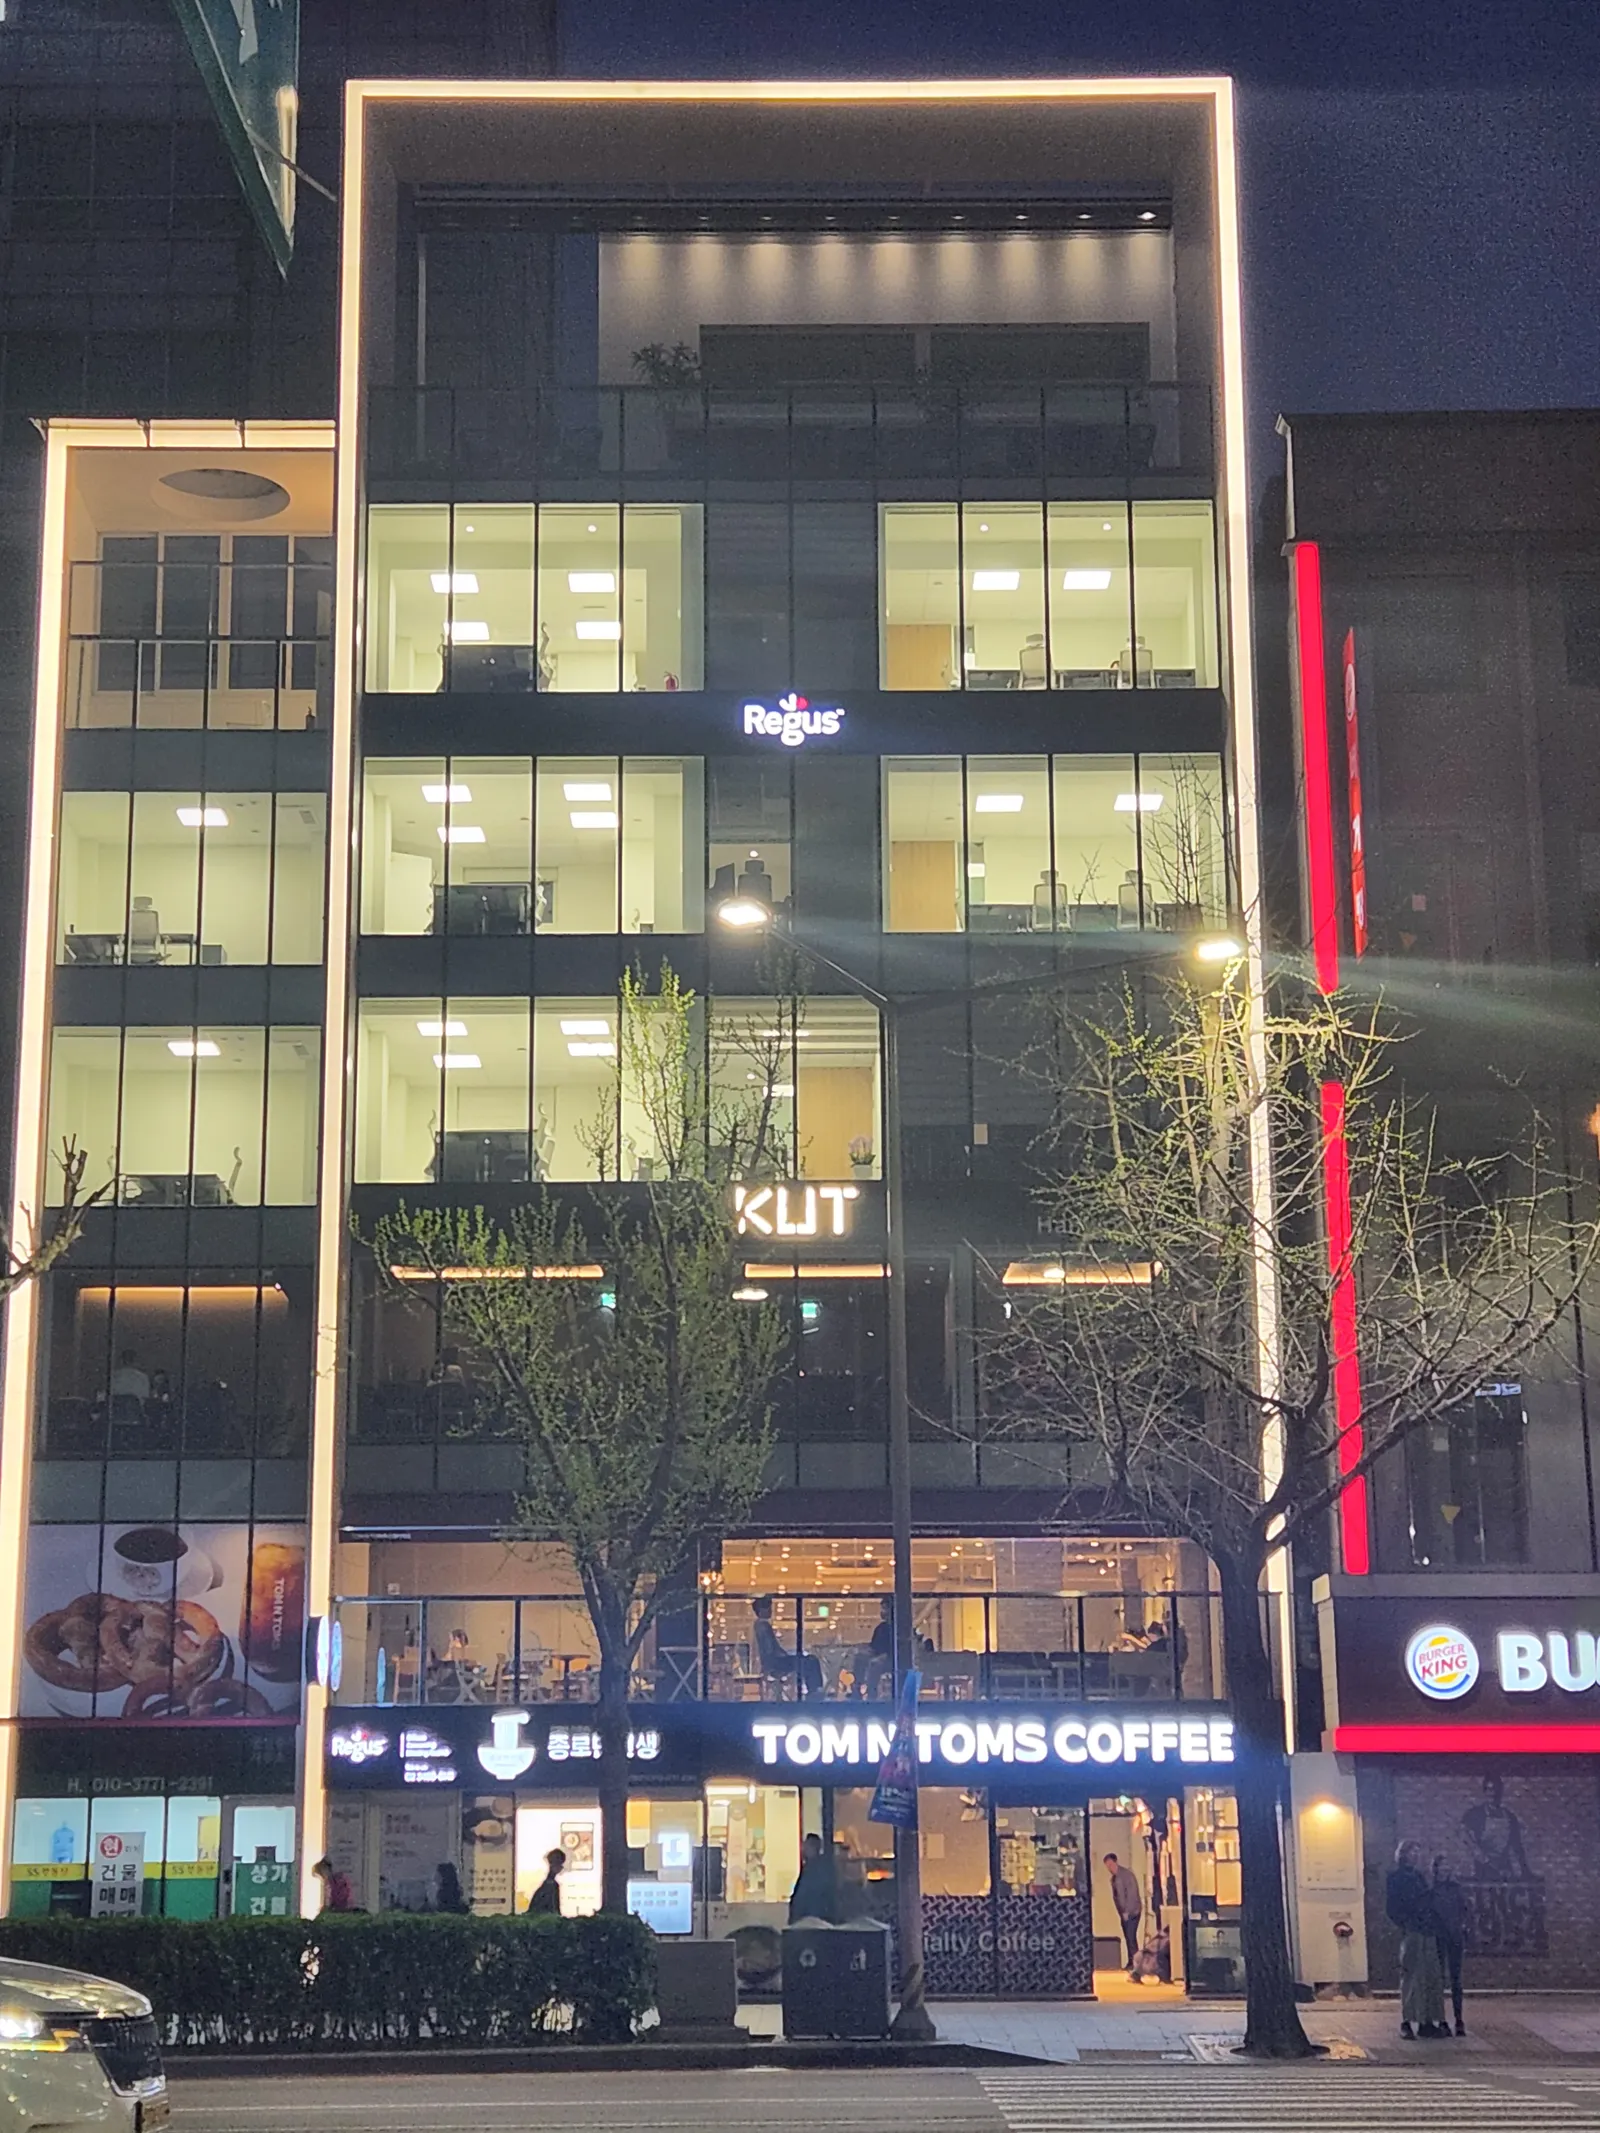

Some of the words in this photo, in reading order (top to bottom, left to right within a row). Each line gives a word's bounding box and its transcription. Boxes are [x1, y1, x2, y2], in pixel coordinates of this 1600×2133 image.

[743, 696, 845, 746] Regus
[1418, 1643, 1466, 1664] BURGER
[1498, 1633, 1600, 1692] BU
[1421, 1655, 1468, 1681] KING
[332, 1732, 388, 1762] Regus
[752, 1723, 860, 1764] TOM
[866, 1723, 897, 1763] N
[914, 1722, 1048, 1764] TOMS
[1053, 1721, 1235, 1764] COFFEE
[101, 1864, 137, 1882] 건물
[250, 1864, 288, 1884] 상가
[978, 1930, 1056, 1952] Coffee
